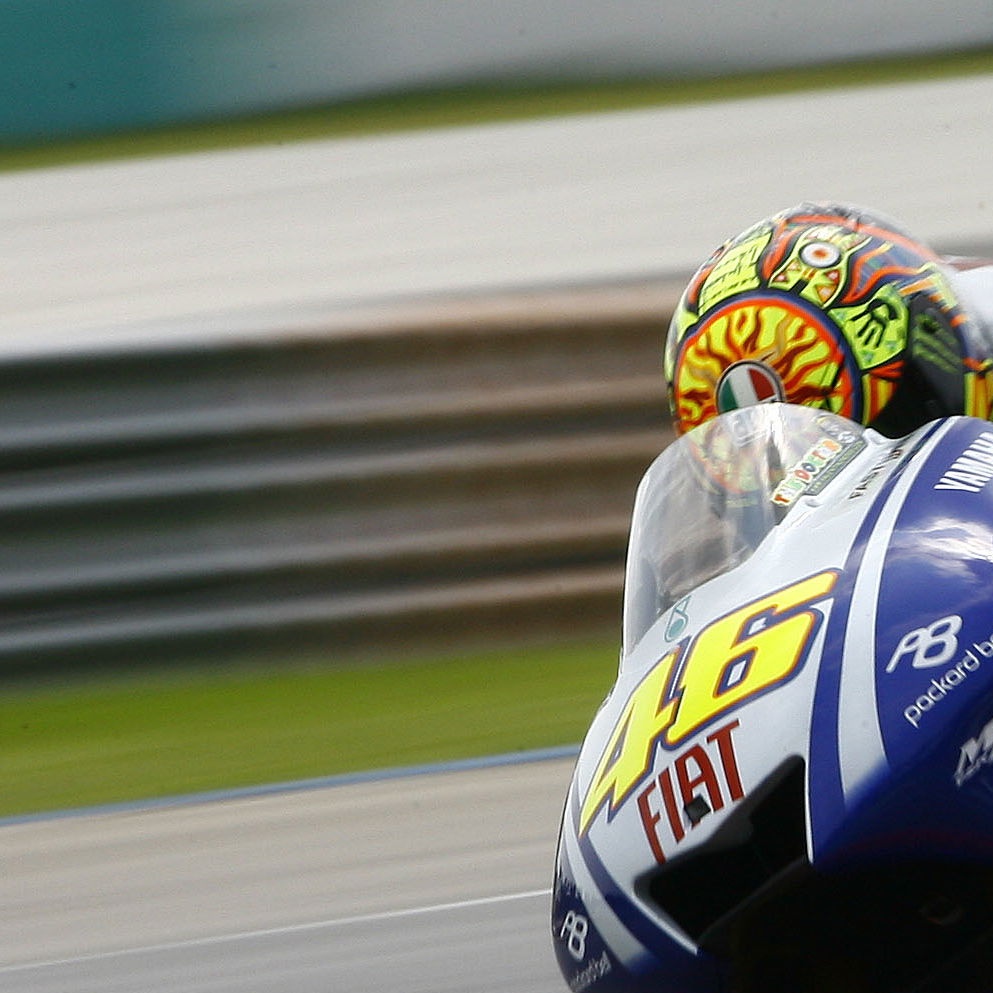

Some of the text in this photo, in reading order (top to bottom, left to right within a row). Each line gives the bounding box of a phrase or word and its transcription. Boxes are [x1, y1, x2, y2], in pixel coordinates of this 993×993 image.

[579, 568, 843, 839] 46
[903, 650, 981, 729] packard
[636, 718, 745, 864] FIAT
